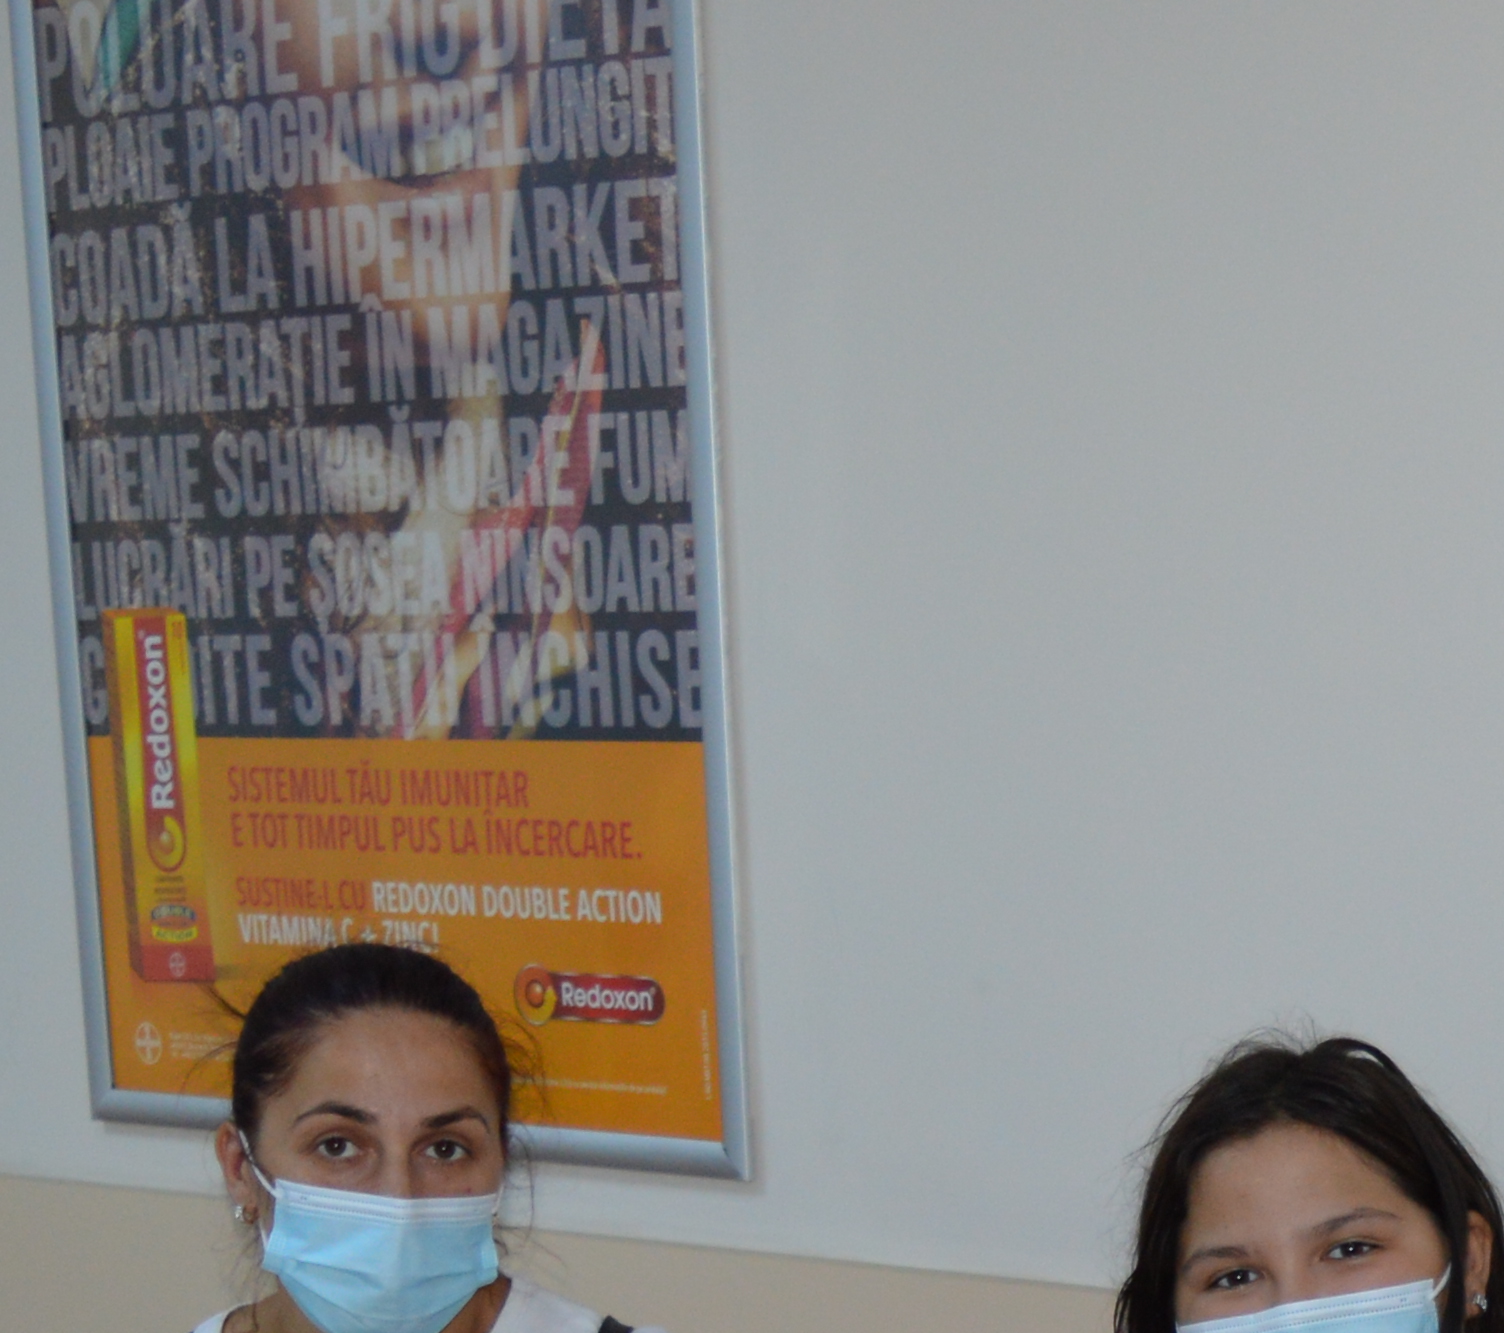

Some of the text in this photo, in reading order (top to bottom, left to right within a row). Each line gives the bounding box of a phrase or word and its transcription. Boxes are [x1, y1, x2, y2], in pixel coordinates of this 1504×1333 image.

[316, 0, 463, 89] FRIG
[43, 54, 677, 213] PLOAIE PROGRAM PRELUNGIT
[49, 174, 680, 328] COADĂ LA HIPERMARKET
[358, 293, 417, 403] ÎN
[428, 288, 687, 399] MAGAZINE
[66, 403, 693, 524] VREME SCHIMBĂTOARE FUM
[71, 517, 236, 621] LUCRĂRI
[243, 532, 297, 620] PE
[459, 522, 696, 615] NINSOARE
[468, 610, 703, 730] ÎNCHISE
[146, 633, 176, 812] Redoxon
[226, 758, 531, 809] SISTEMUL TĂU IMUNITAR
[230, 808, 644, 861] E TOT TIMPUL PUS LA ÎNCERCARE.
[237, 913, 338, 949] VITAMINA
[338, 878, 366, 912] CU
[371, 881, 477, 917] REDOXON
[481, 883, 571, 921] DOUBLE
[576, 889, 663, 925] ACTION
[561, 982, 654, 1012] Redoxon
